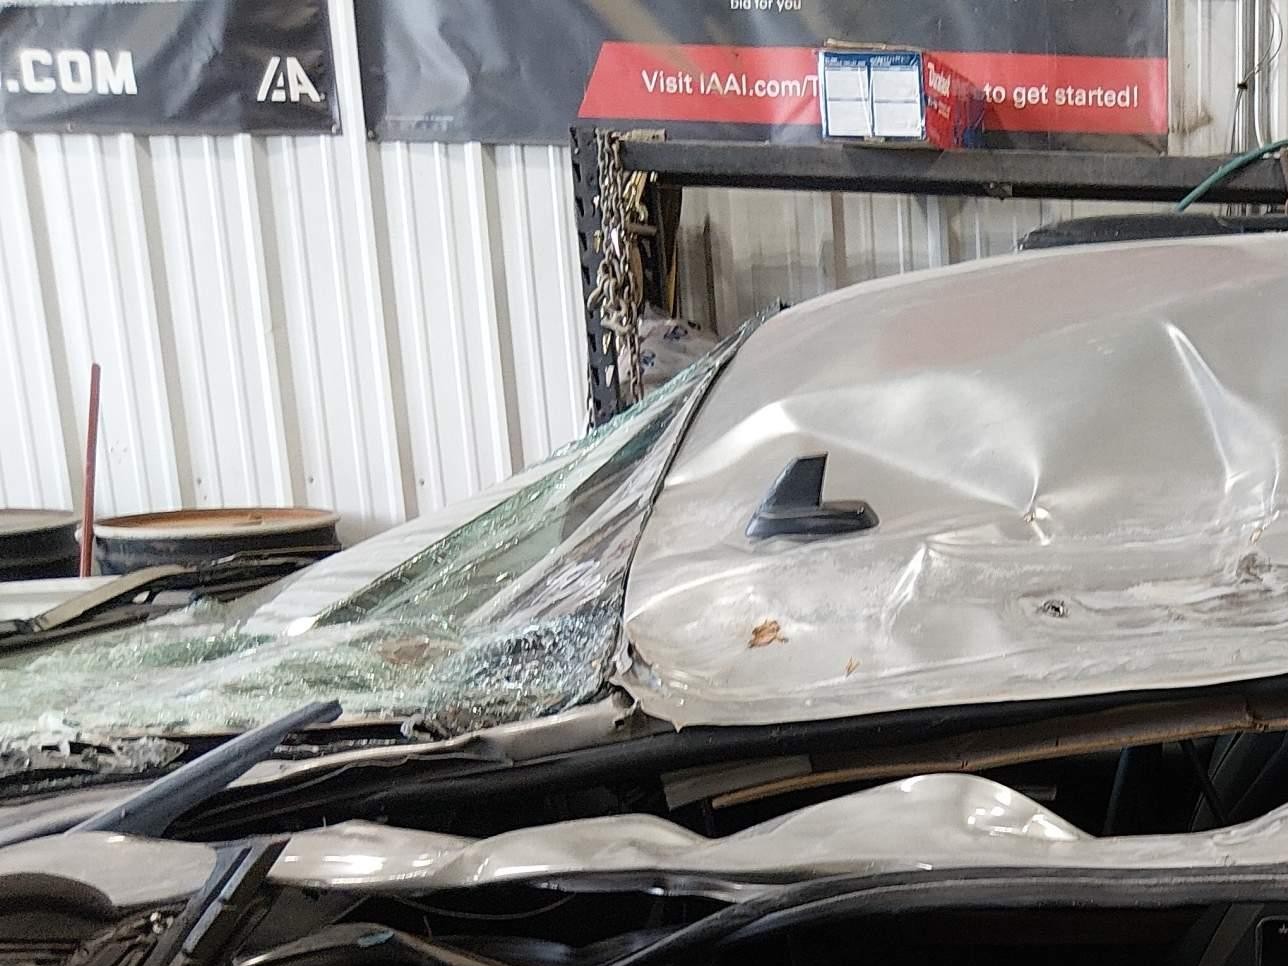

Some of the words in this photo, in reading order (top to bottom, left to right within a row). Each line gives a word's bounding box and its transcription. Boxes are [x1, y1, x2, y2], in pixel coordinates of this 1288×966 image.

[730, 0, 751, 10] bid
[754, 0, 773, 10] for
[776, 0, 801, 13] you
[0, 48, 137, 95] .COM
[641, 70, 693, 94] Visit
[700, 72, 819, 98] IAAI.com/T
[983, 82, 1006, 104] to
[1012, 84, 1049, 109] get
[1055, 85, 1139, 109] started!
